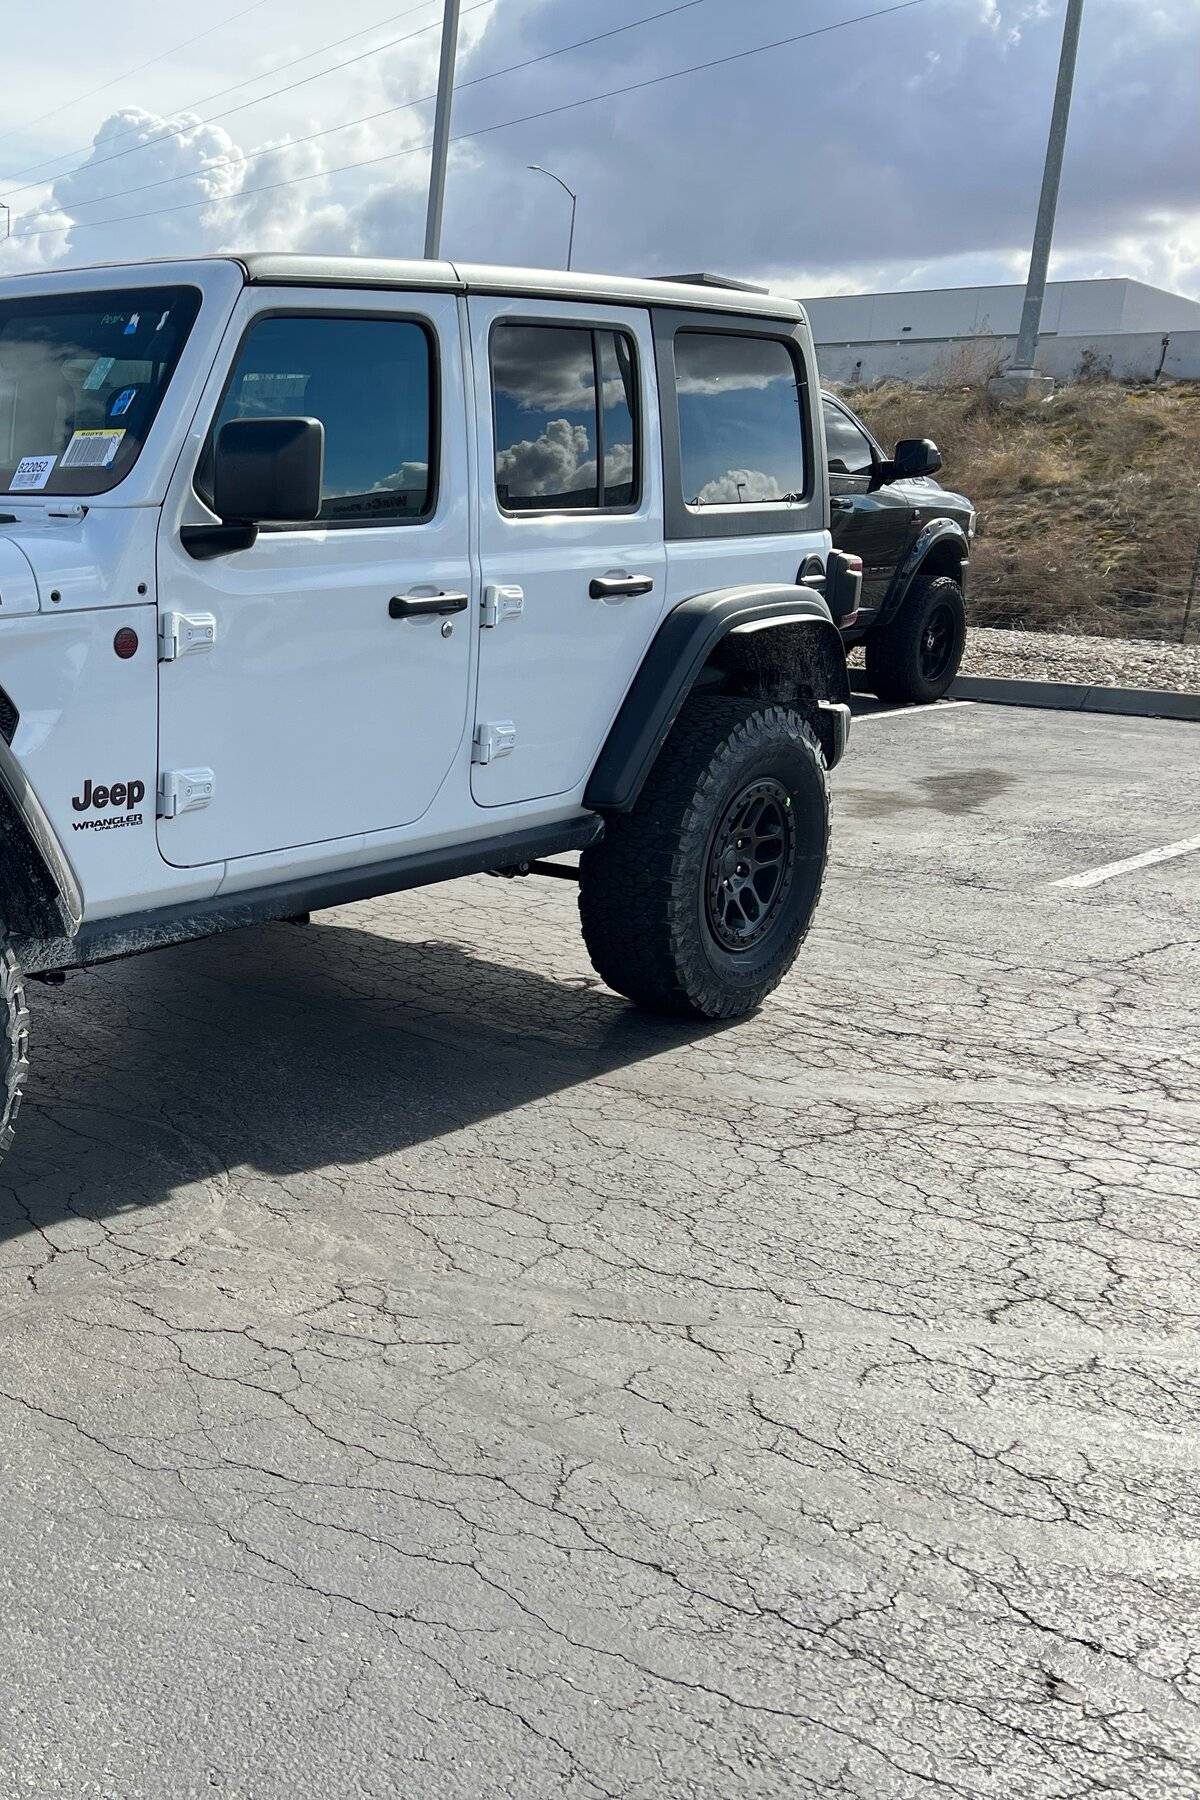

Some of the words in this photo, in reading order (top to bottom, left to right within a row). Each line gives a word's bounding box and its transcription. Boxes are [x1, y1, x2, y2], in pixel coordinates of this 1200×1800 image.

[72, 779, 145, 811] Jeep
[72, 813, 143, 831] WRANGLER
[94, 820, 143, 832] UNLIMITED
